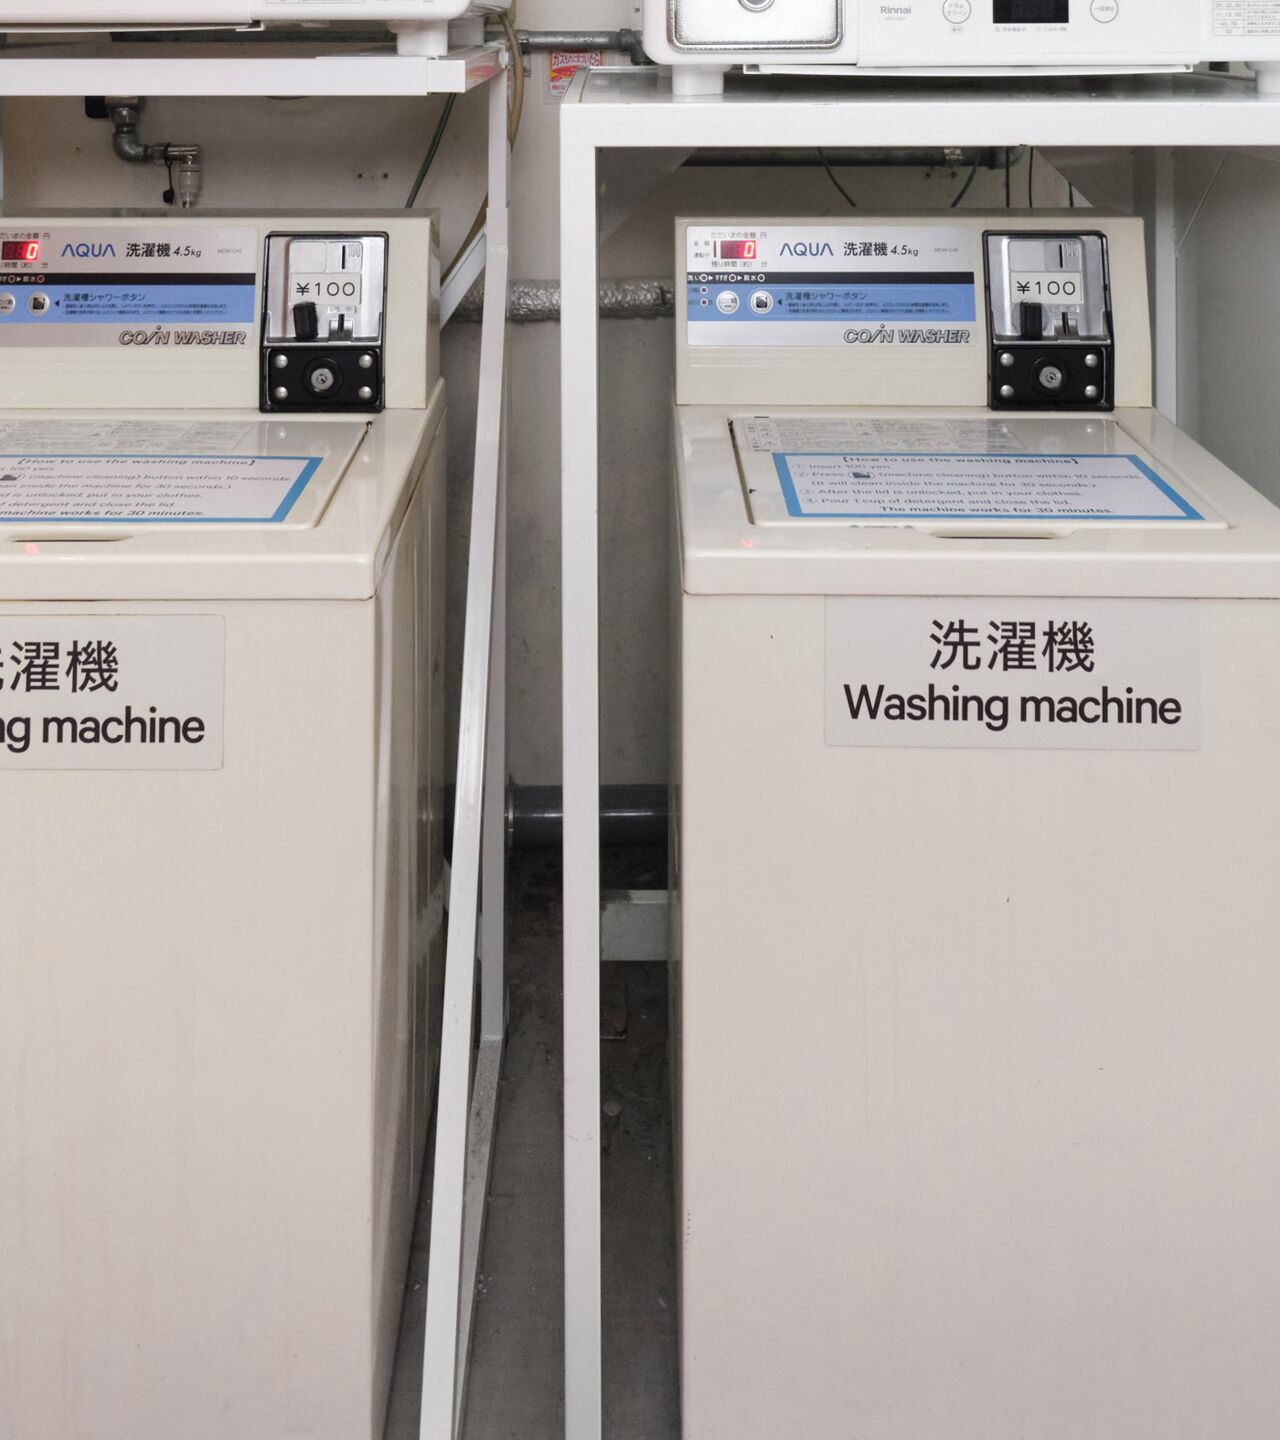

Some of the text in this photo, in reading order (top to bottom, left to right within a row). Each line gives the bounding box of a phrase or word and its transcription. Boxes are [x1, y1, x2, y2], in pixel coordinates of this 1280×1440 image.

[880, 5, 912, 15] Rinnai
[27, 243, 39, 259] 0
[125, 242, 171, 258] 洗濯機
[173, 246, 202, 258] 4.5kg
[743, 241, 755, 258] 0
[843, 242, 888, 257] 洗濯機
[890, 245, 919, 257] 4.5kg
[296, 281, 355, 297] ¥100
[1016, 280, 1076, 296] ¥100
[119, 325, 246, 345] COIN WASHER
[843, 324, 970, 344] COIN WASHER
[929, 619, 1095, 673] 洗濯機
[843, 683, 1182, 732] Washing machine
[42, 705, 205, 744] machine
